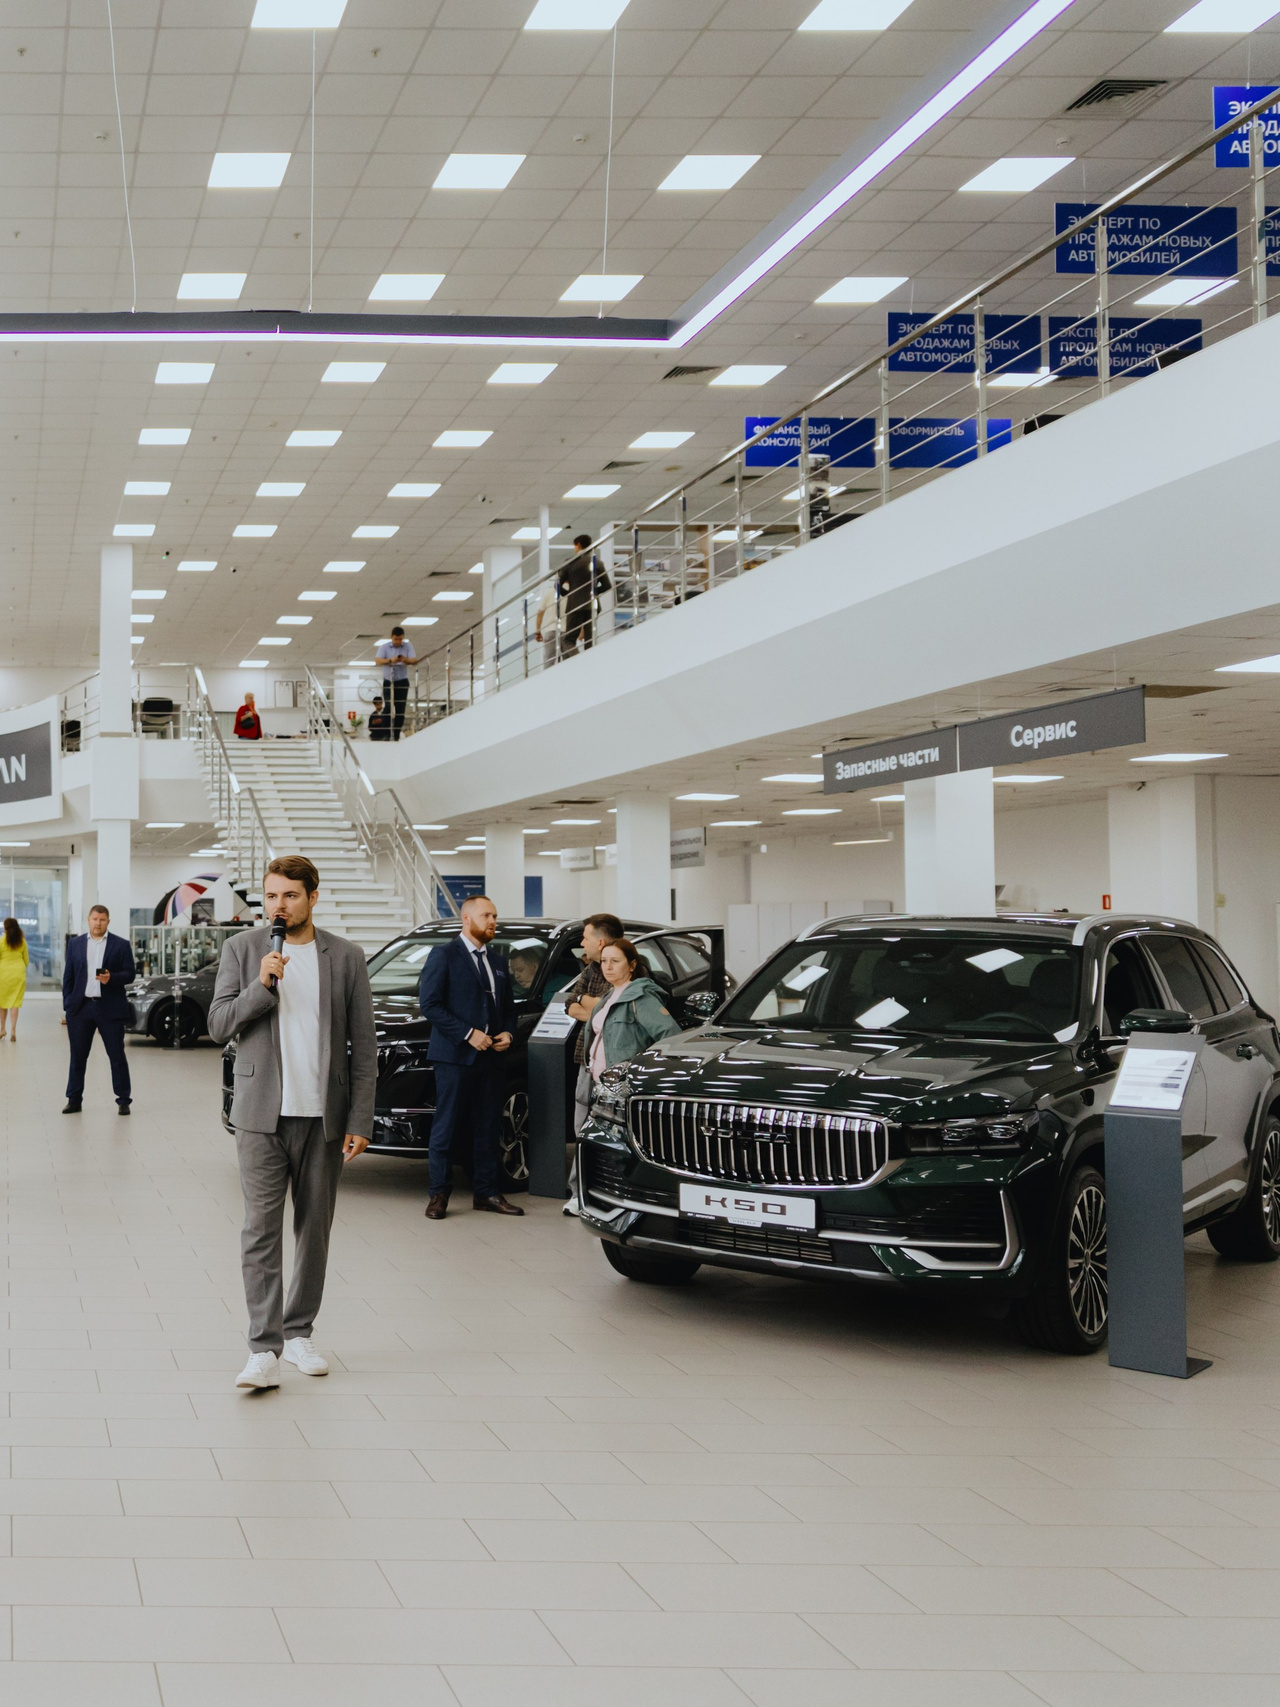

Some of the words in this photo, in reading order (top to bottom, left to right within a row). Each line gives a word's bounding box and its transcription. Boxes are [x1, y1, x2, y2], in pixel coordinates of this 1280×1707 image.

[1139, 217, 1161, 230] ПО
[1068, 233, 1154, 246] ПРОАЖАМ
[1159, 235, 1213, 248] НОВЫХ
[1068, 249, 1180, 264] АВТМОБИЛЕЙ
[898, 351, 993, 364] АВТОМОБИЛЙ
[1010, 719, 1077, 749] Сервис
[835, 755, 897, 781] Запасные
[899, 746, 940, 767] части
